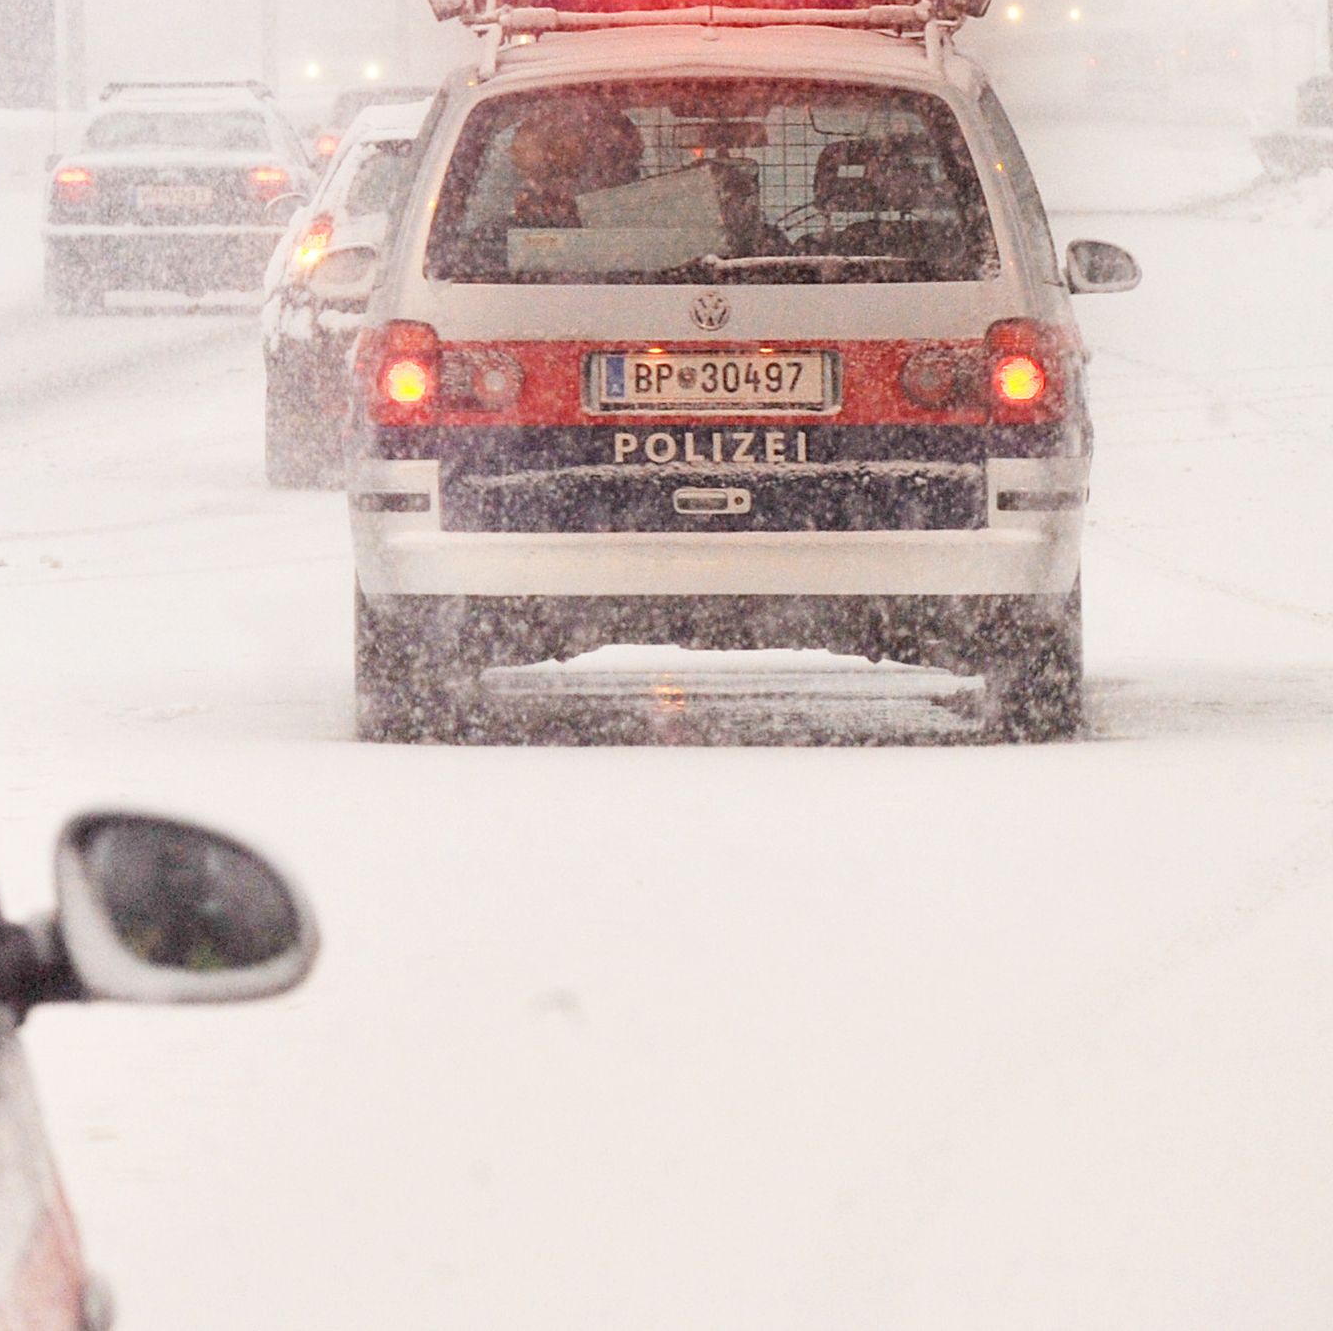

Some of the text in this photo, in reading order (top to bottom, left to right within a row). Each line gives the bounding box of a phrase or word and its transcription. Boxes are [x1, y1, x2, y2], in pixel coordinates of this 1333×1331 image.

[635, 362, 804, 394] BP 30497
[614, 431, 808, 463] POLIZEI
